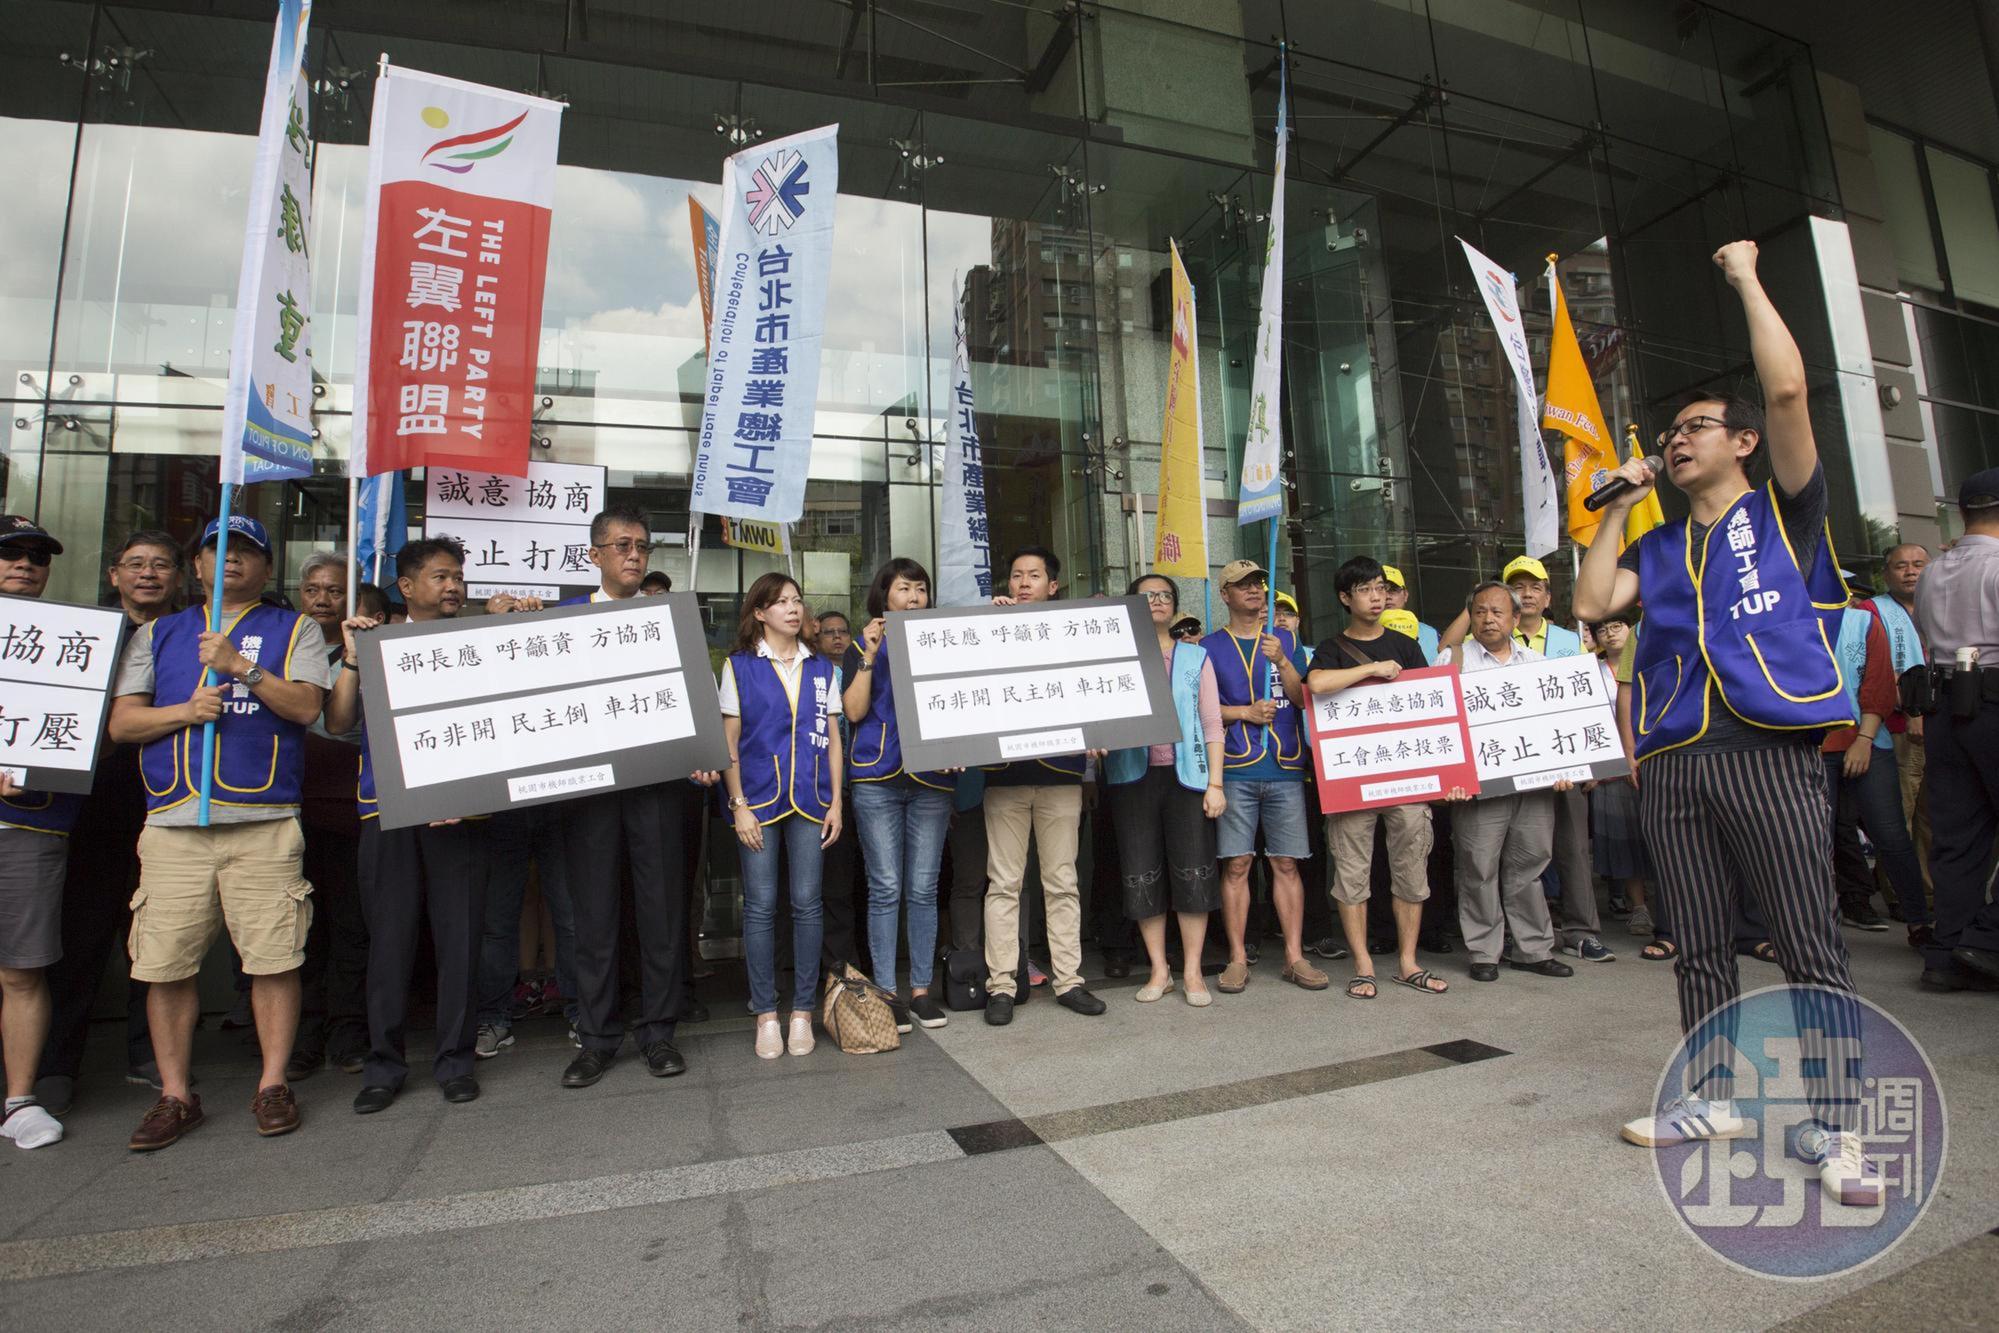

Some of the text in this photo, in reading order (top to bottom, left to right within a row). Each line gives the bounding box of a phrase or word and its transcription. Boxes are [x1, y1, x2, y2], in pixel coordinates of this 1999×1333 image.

[396, 207, 472, 436] 左翼聯盟
[460, 219, 505, 440] THE LEFT PARTY
[436, 472, 593, 514] 誠意協商
[1726, 506, 1761, 594] 機師工會
[1729, 590, 1781, 620] TUP
[0, 624, 99, 673] 協商
[397, 620, 662, 675] 部長應呼籲資方協商
[916, 615, 1121, 650] 部長應呼籲資方協商
[222, 701, 260, 715] TUP
[928, 672, 1137, 713] 而非開民主倒車打壓
[1275, 699, 1290, 709] UP
[1323, 688, 1446, 722] 資方無意協商
[1463, 669, 1594, 714] 誠意協商
[413, 687, 678, 752] 而非開民主倒車打壓
[809, 732, 830, 749] TUP
[1332, 735, 1454, 768] 工會無奈投票
[1477, 721, 1612, 767] 停止打壓
